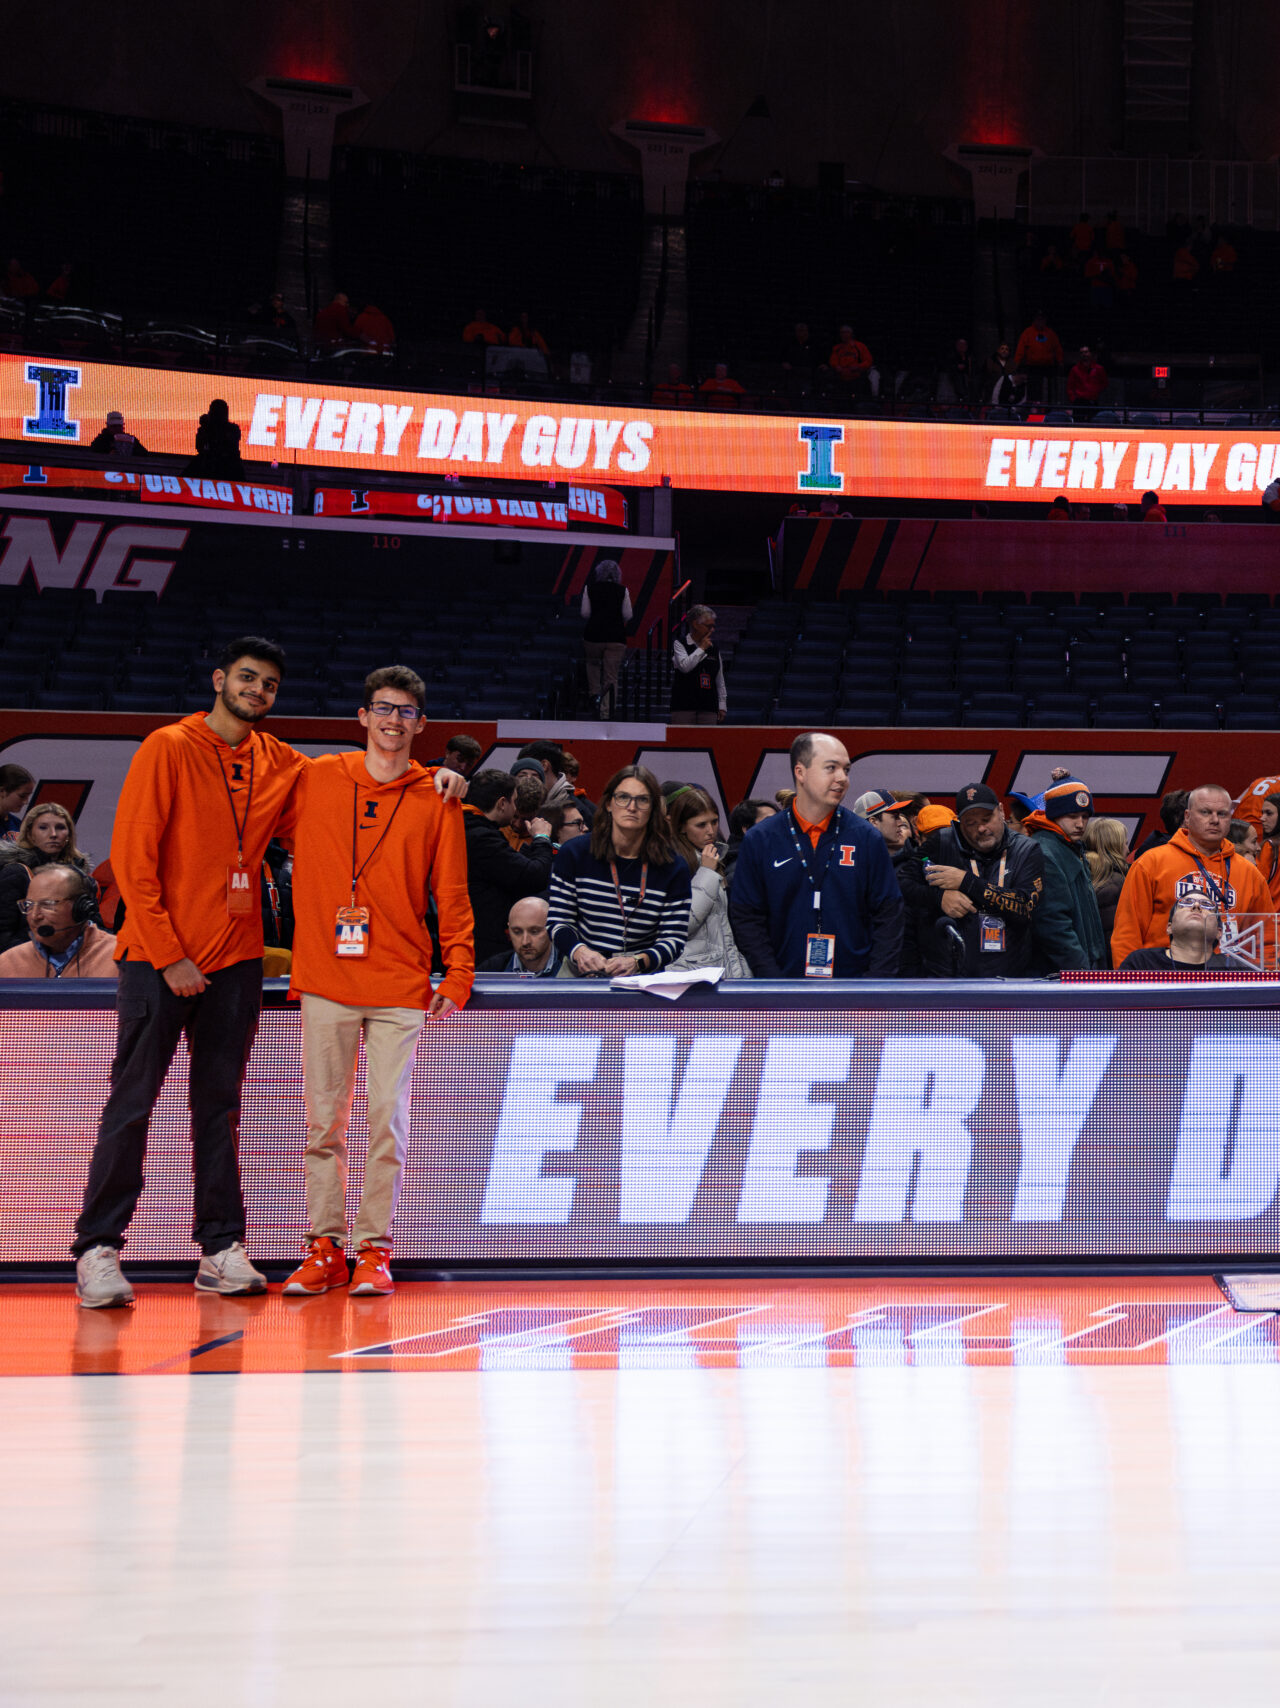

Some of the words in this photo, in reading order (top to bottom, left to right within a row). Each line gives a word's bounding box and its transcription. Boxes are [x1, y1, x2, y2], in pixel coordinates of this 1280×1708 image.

[248, 393, 413, 456] EVERY
[417, 407, 517, 464] DAY
[519, 414, 654, 473] GUYS
[985, 438, 1129, 490] EVERY
[1132, 442, 1221, 491] DAY
[371, 535, 401, 549] 110
[1252, 779, 1277, 796] 6
[231, 872, 250, 889] AA
[340, 925, 364, 942] AA
[984, 928, 1001, 941] ME
[480, 1033, 1120, 1226] EVERY
